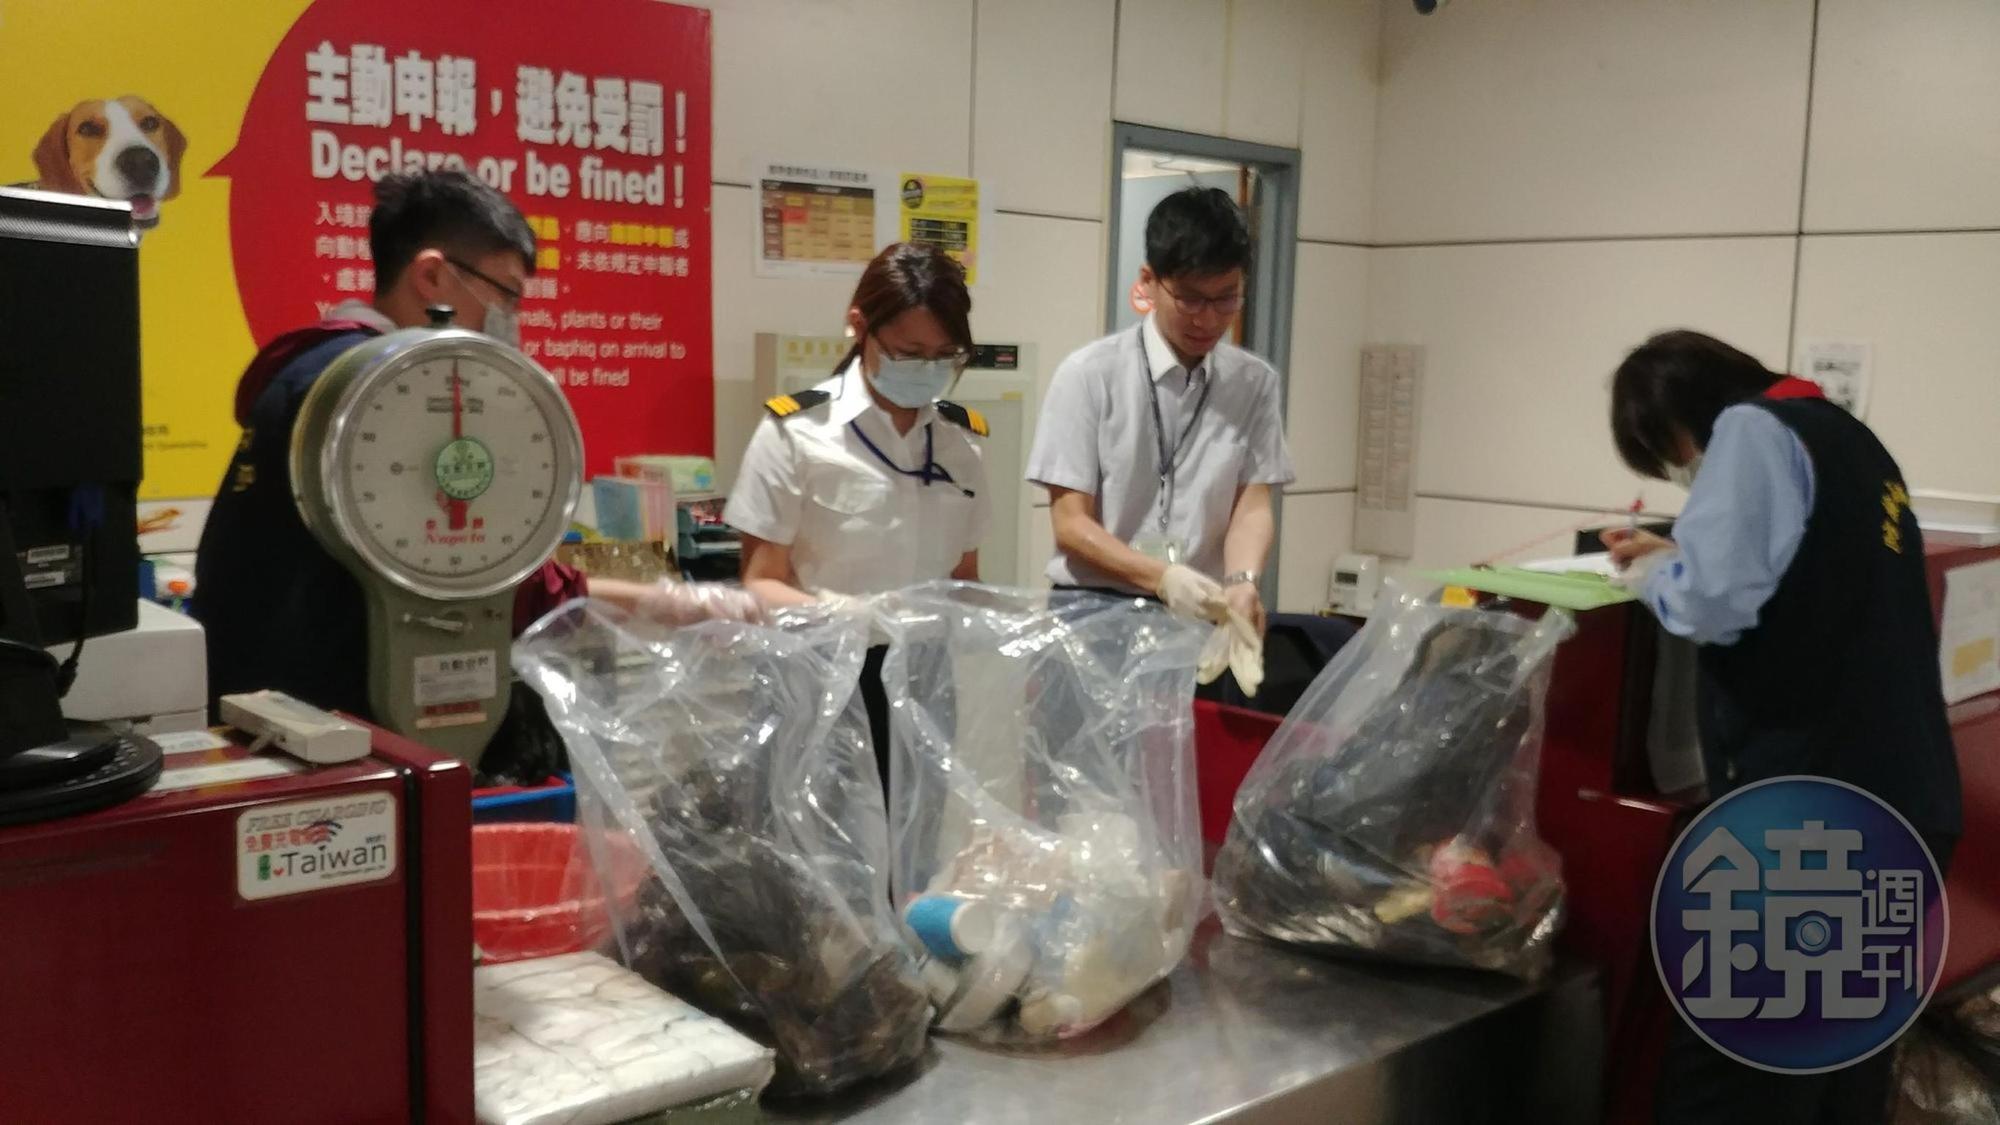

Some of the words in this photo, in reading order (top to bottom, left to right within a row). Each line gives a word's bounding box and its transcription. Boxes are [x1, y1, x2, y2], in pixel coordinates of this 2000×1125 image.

[476, 155, 518, 193] or
[525, 150, 571, 198] be
[561, 309, 607, 332] plants
[609, 315, 626, 329] or
[629, 312, 664, 330] their
[599, 344, 619, 358] on
[622, 342, 668, 358] arrival
[669, 342, 686, 360] to
[569, 367, 590, 387] be
[592, 367, 630, 387] fined
